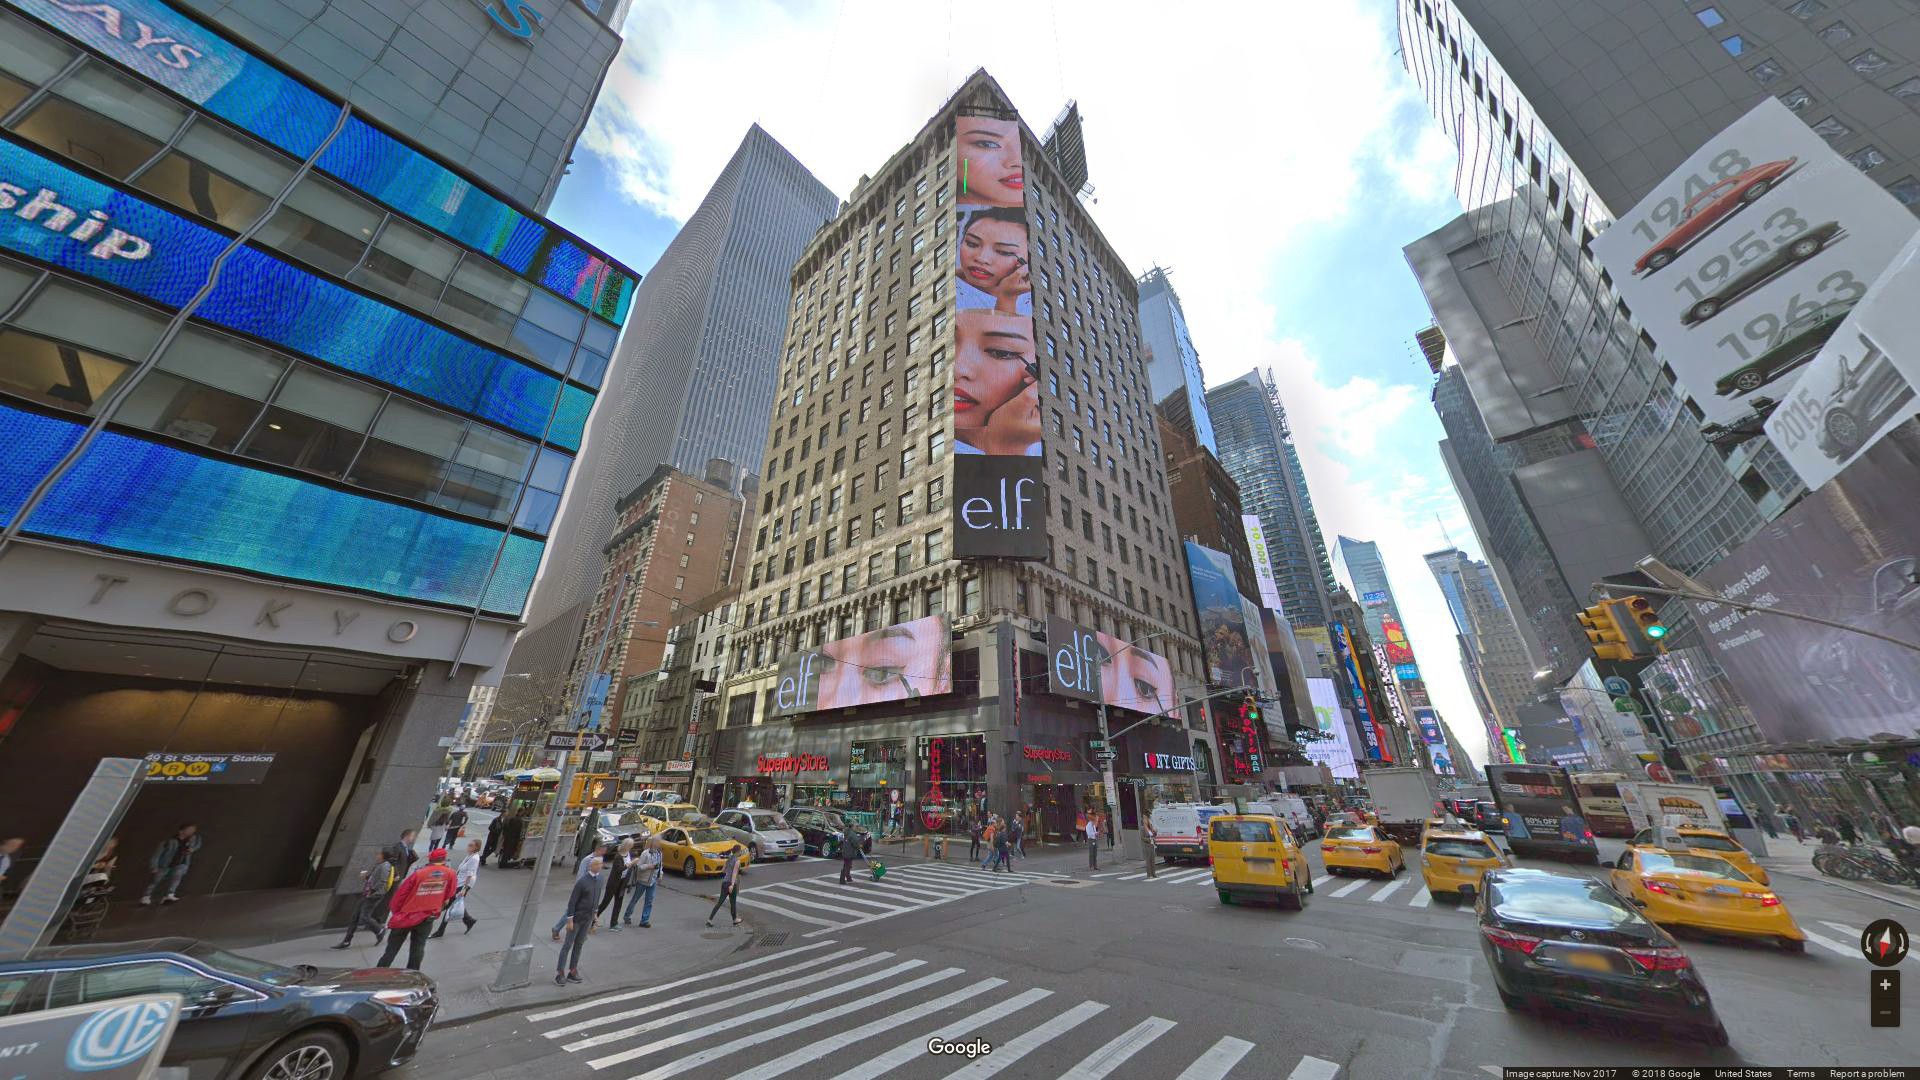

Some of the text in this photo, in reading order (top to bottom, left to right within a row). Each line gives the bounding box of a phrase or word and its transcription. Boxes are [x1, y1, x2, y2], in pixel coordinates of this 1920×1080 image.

[1631, 149, 1751, 242] 1948
[1674, 206, 1809, 301] 1953
[1716, 270, 1869, 362] 1963
[1773, 387, 1823, 452] 2015
[1744, 565, 1771, 586] been
[90, 573, 419, 644] TOKYO
[182, 755, 228, 763] Subway
[555, 737, 600, 746] ONE WAY
[756, 751, 799, 776] Superdry
[1171, 755, 1196, 770] GIFTS
